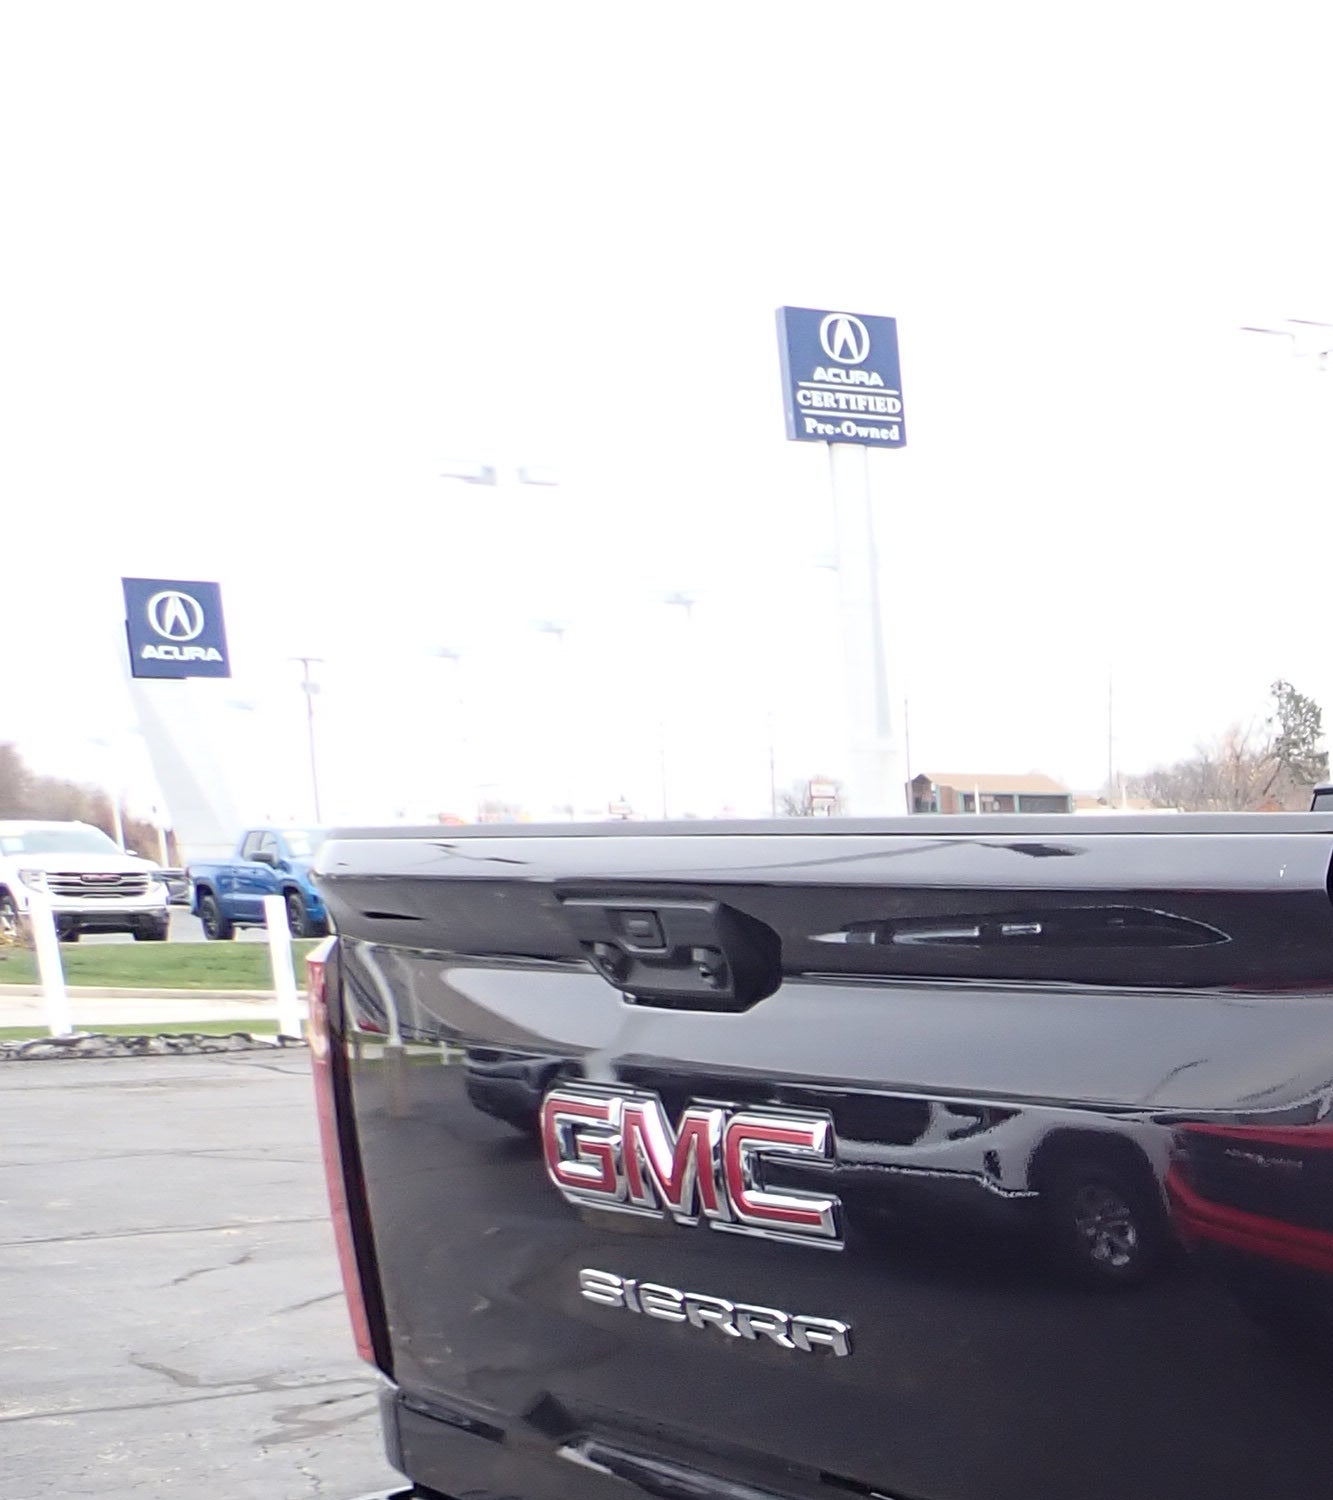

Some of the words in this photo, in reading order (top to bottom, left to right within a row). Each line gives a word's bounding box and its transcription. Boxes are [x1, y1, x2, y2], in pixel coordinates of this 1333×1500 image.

[813, 366, 884, 387] ACURA
[797, 390, 902, 413] CERTIFIED
[804, 417, 900, 440] Pre-Owned
[141, 644, 223, 662] ACURA
[540, 1084, 844, 1250] GMC
[579, 1268, 850, 1356] SIERRA
